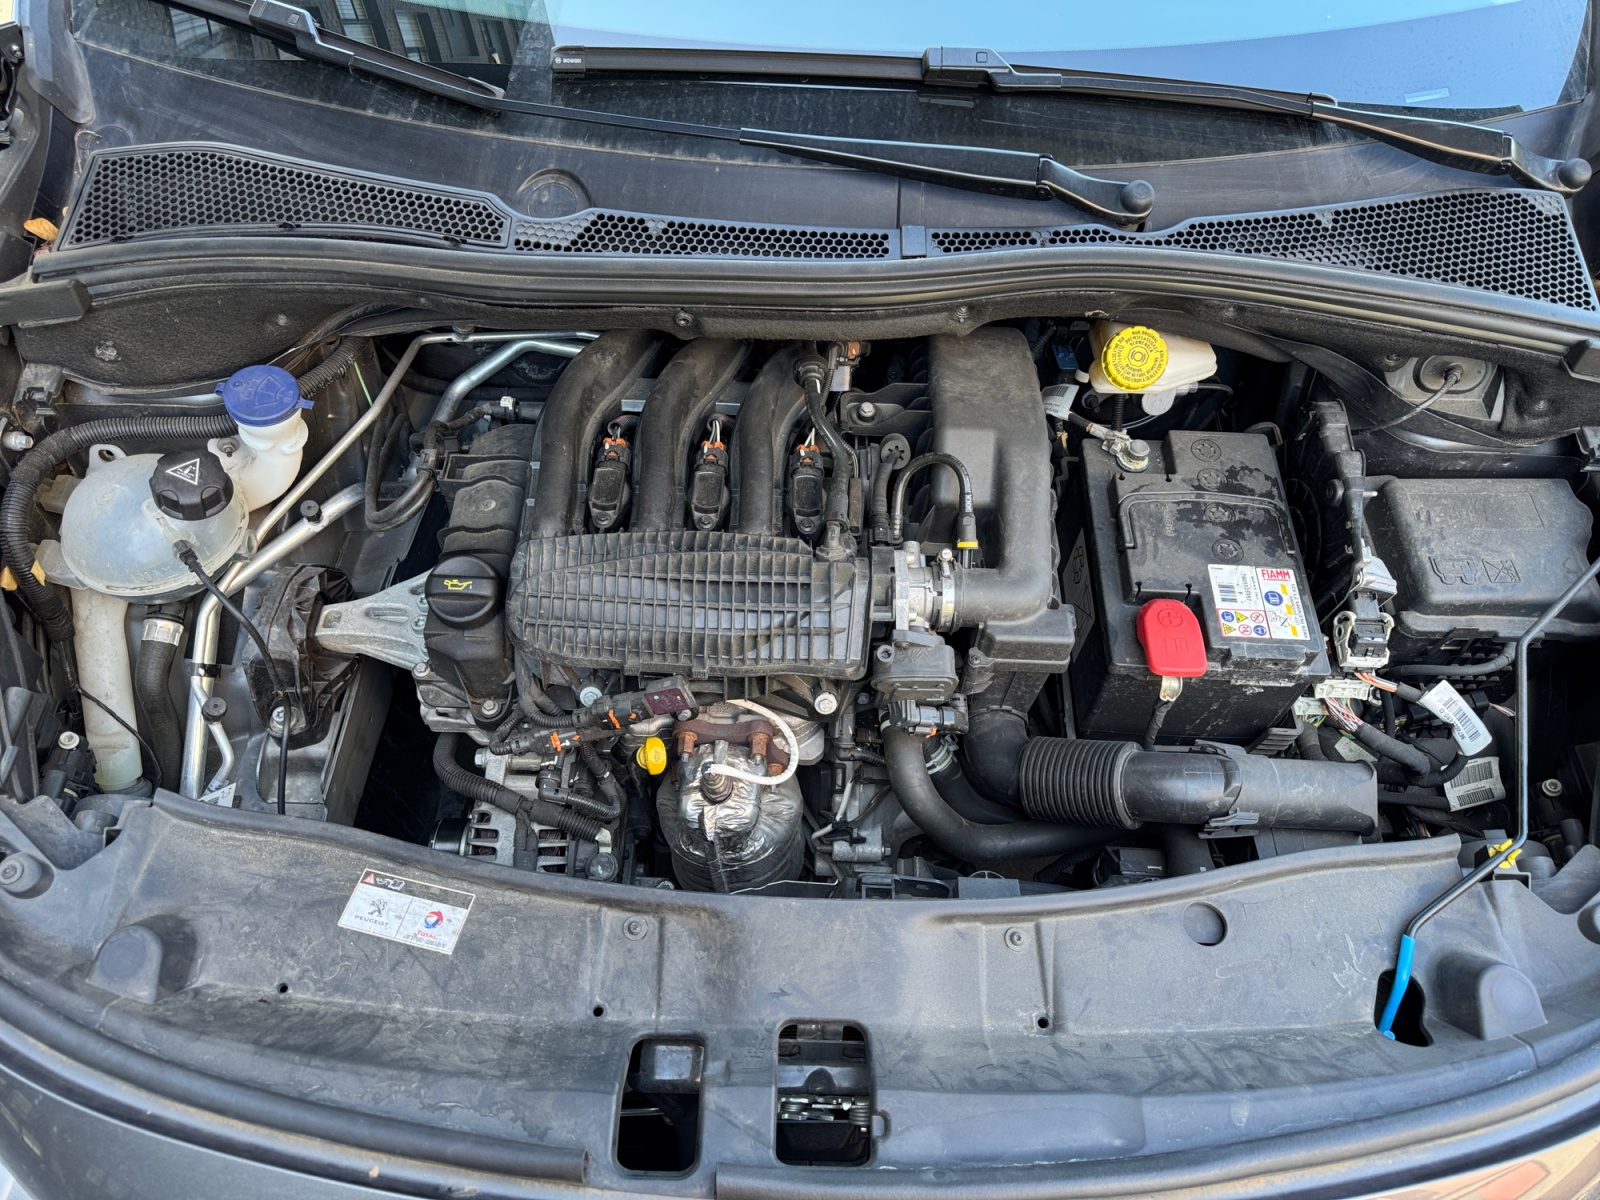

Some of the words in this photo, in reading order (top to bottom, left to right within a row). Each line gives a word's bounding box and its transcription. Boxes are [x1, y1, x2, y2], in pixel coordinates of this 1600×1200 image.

[1262, 569, 1290, 579] FIAMM
[354, 914, 389, 928] PEUGEOT
[416, 930, 438, 940] TOTAL
